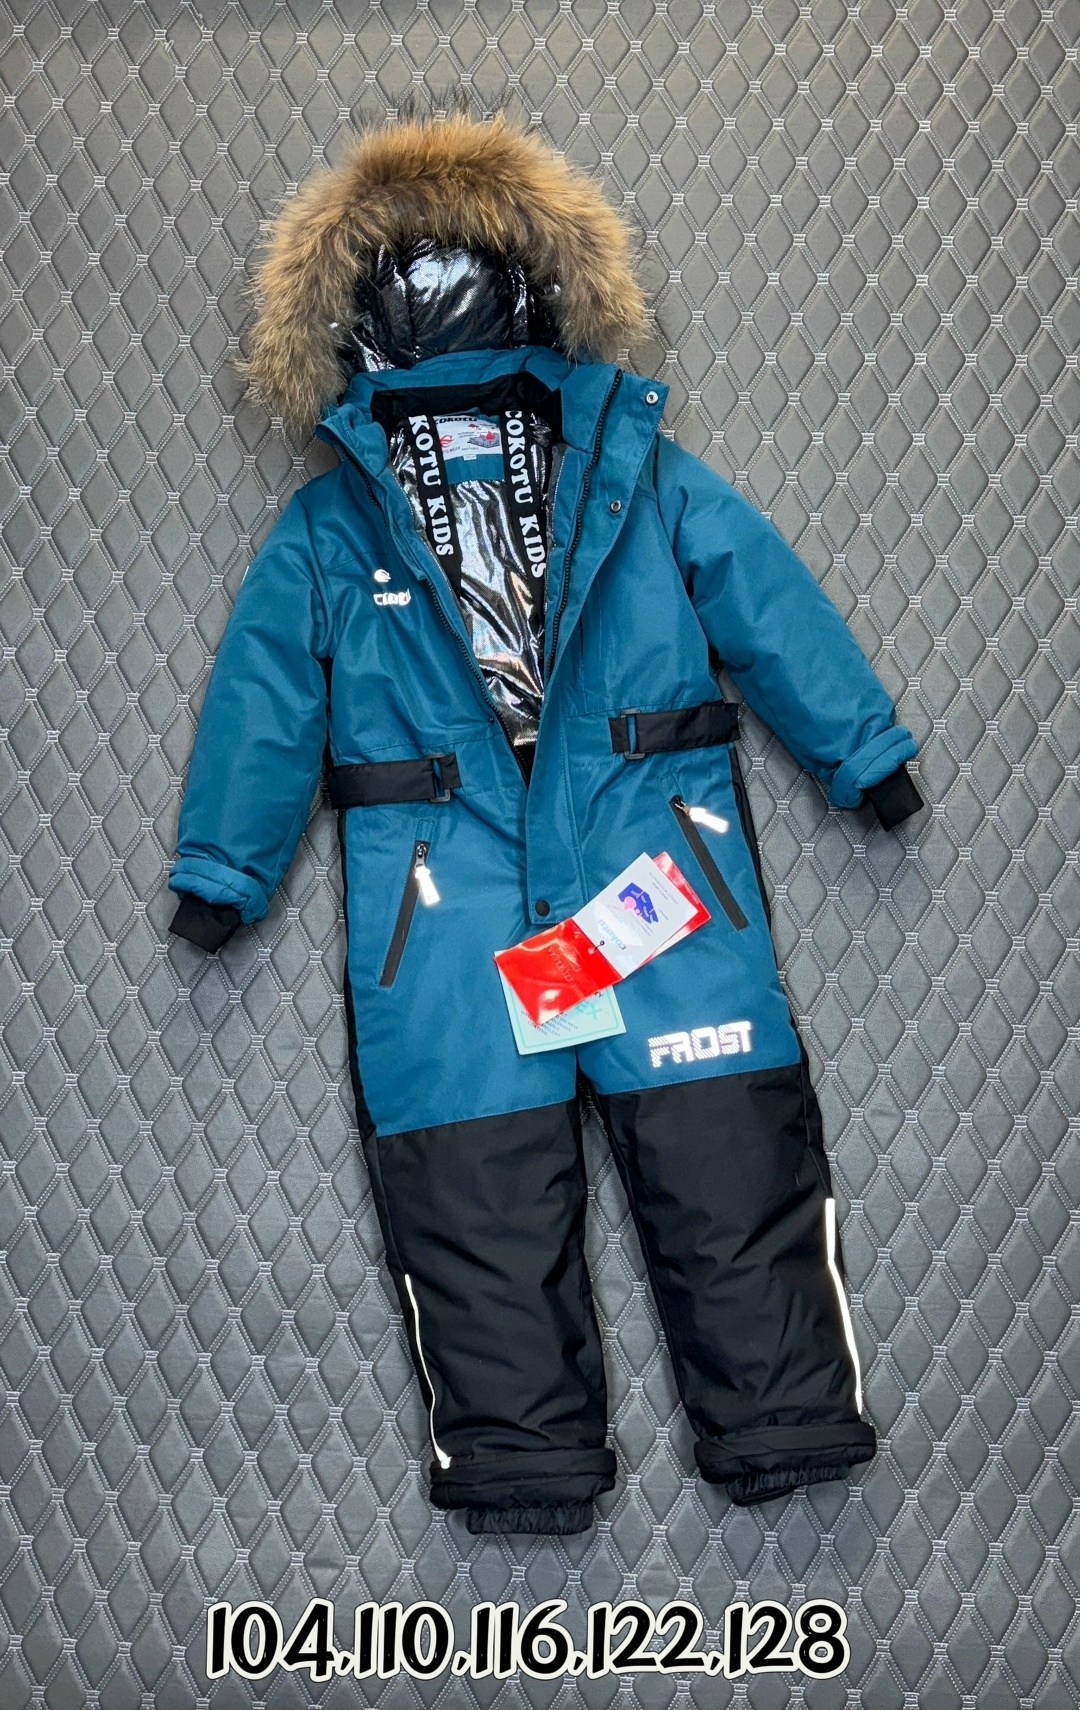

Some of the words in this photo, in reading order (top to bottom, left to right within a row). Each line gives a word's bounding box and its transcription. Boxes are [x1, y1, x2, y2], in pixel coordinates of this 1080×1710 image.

[427, 495, 454, 556] KIDS
[519, 514, 546, 578] KIDS
[648, 1021, 752, 1068] FROST
